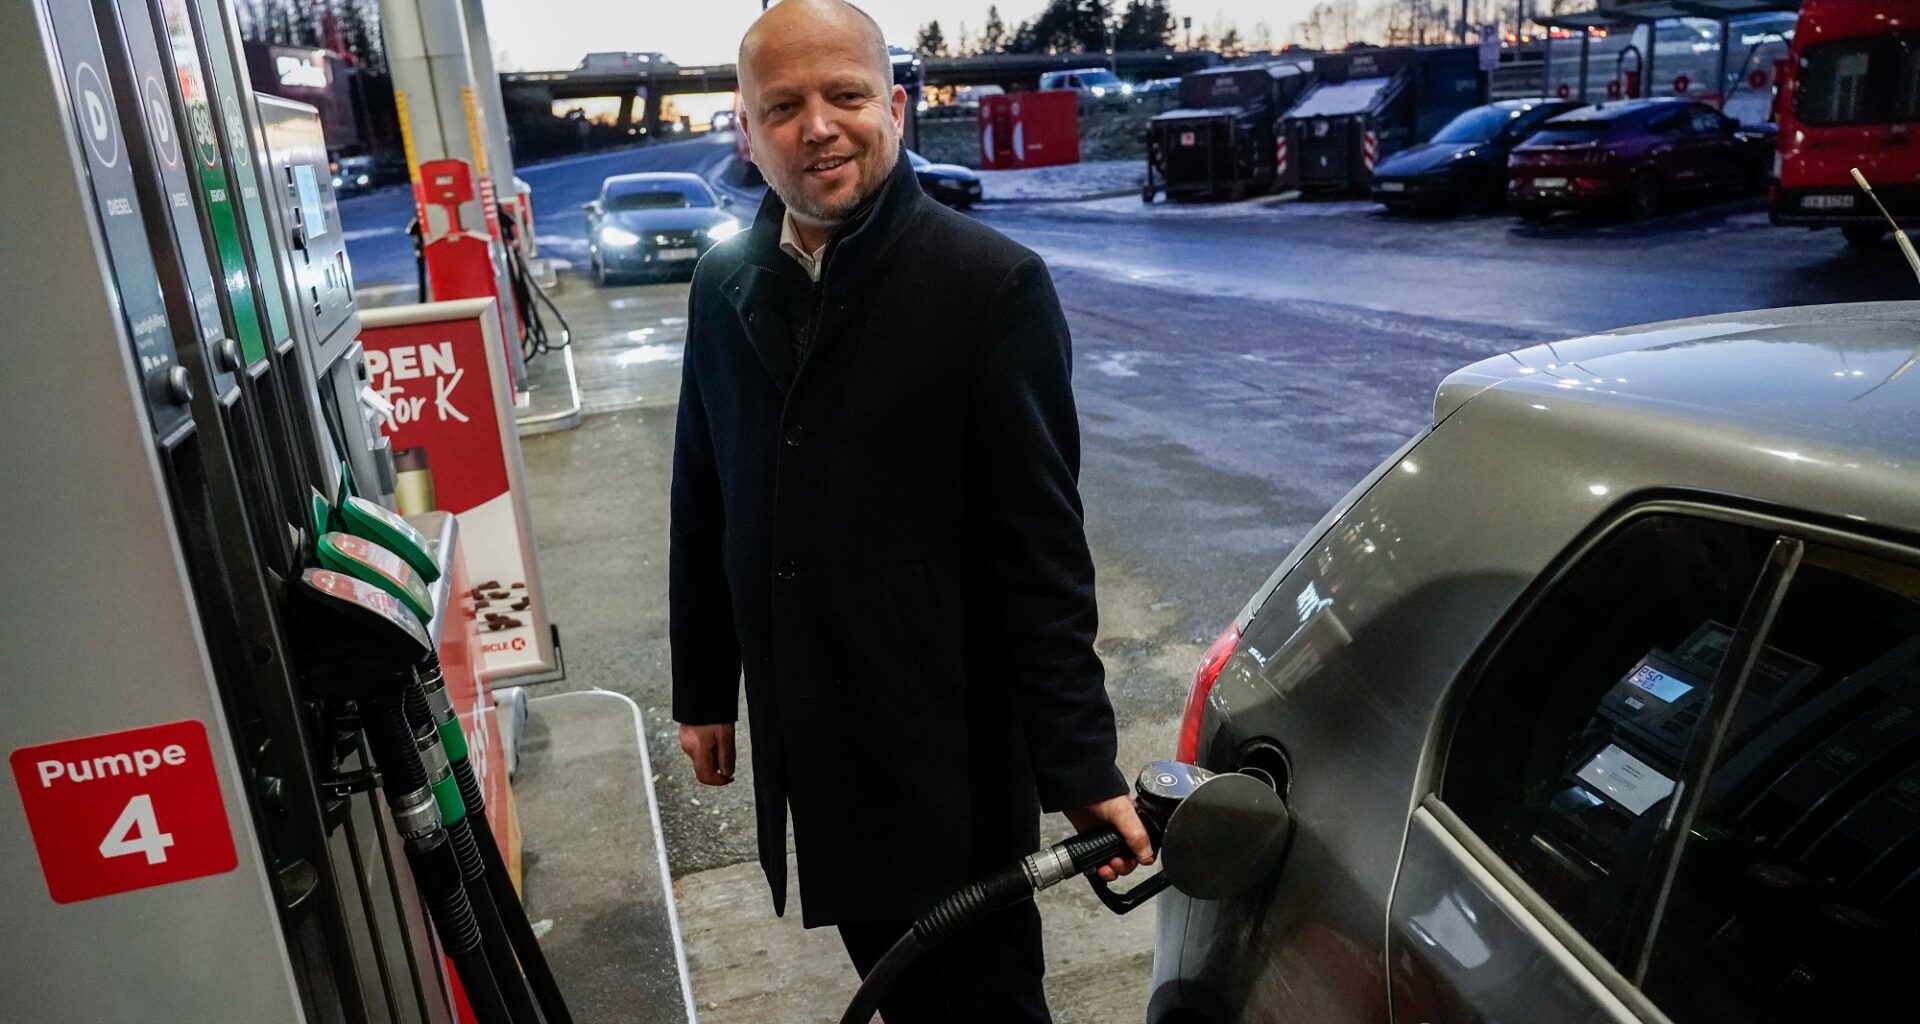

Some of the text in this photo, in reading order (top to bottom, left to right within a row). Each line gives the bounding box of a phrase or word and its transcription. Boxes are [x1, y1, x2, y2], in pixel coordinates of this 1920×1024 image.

[84, 90, 108, 141] D
[151, 100, 169, 143] D
[227, 114, 245, 148] 95
[363, 341, 456, 383] PEN
[377, 368, 470, 432] tor K
[36, 743, 187, 788] Pumpe
[98, 794, 174, 865] 4
